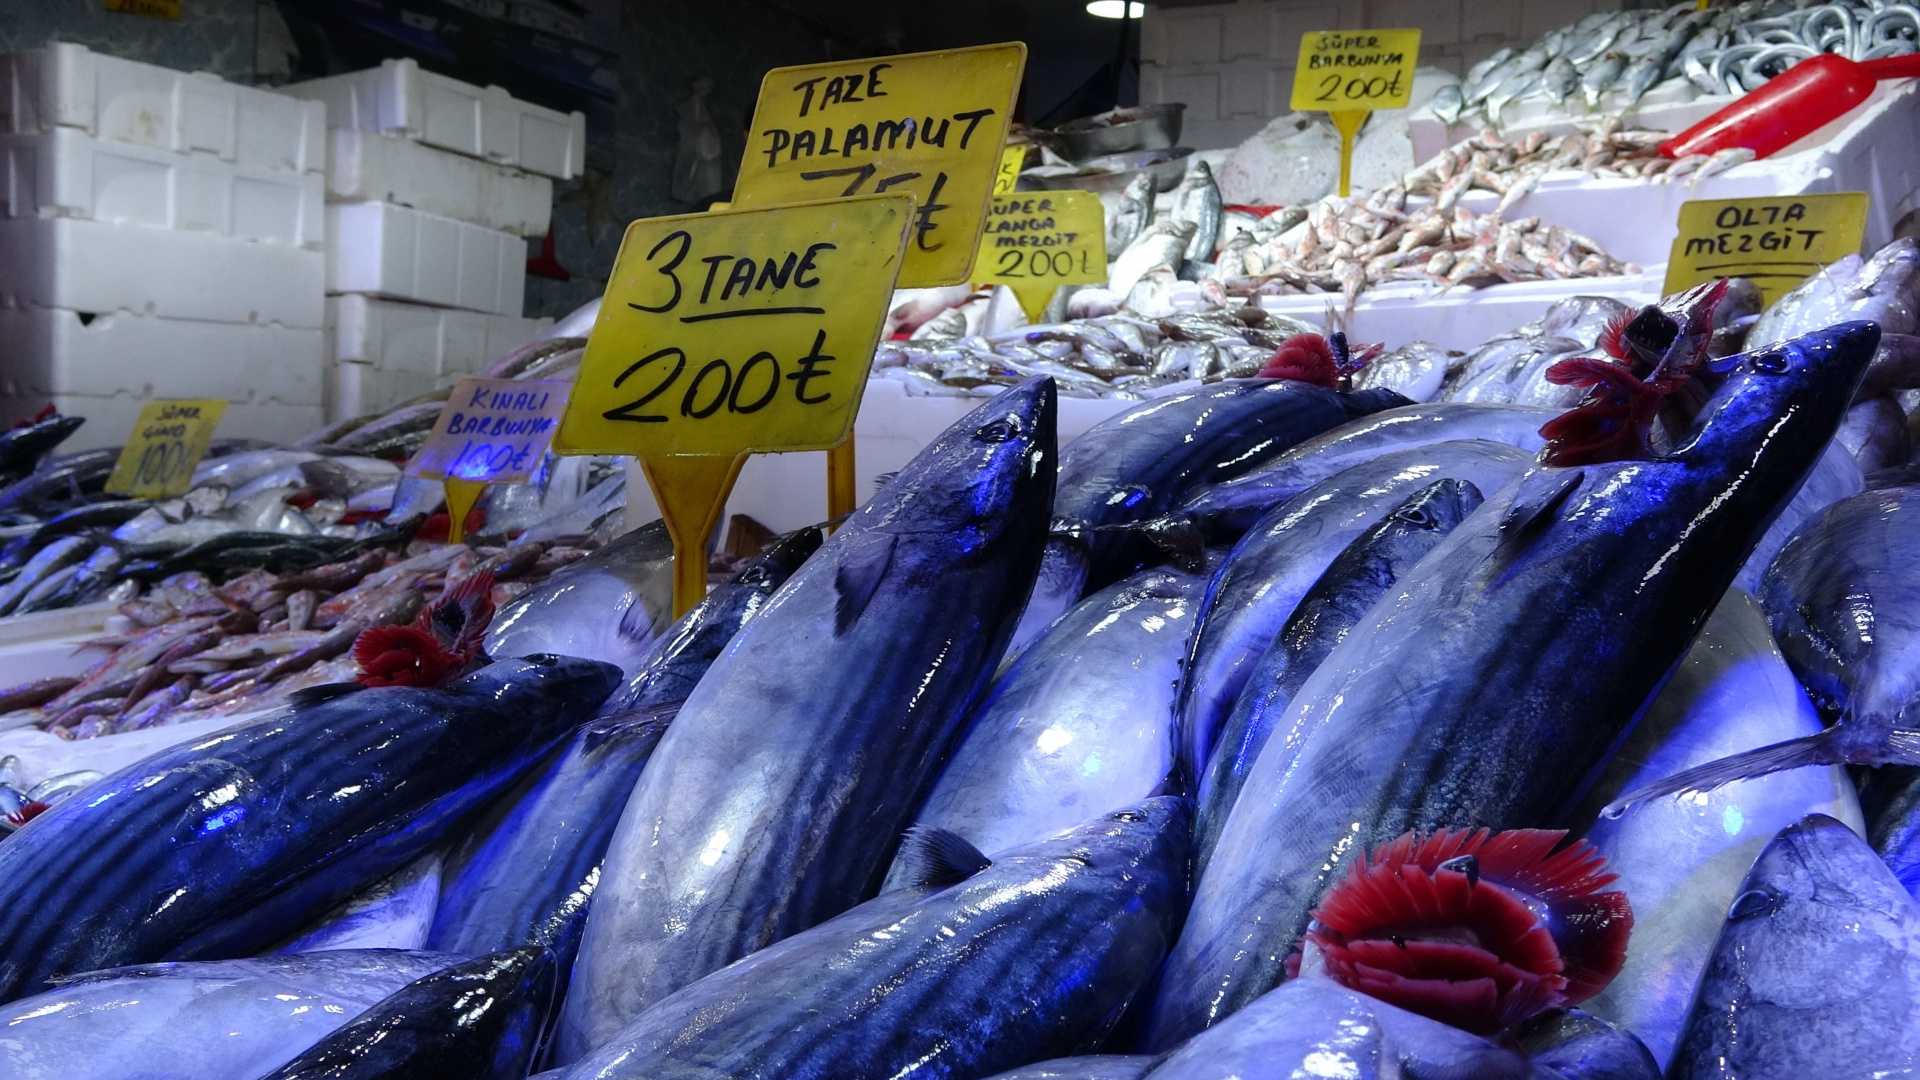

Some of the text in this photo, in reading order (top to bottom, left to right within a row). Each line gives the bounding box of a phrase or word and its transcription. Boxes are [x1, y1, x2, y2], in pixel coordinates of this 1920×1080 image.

[1309, 53, 1404, 69] BARBUNYA
[793, 64, 893, 118] TAZE
[762, 108, 995, 168] PALAMUT
[1716, 203, 1806, 229] OLTA
[628, 230, 837, 314] 3 TANE
[469, 387, 549, 411] KINALI
[446, 412, 552, 436] BARBUNYA
